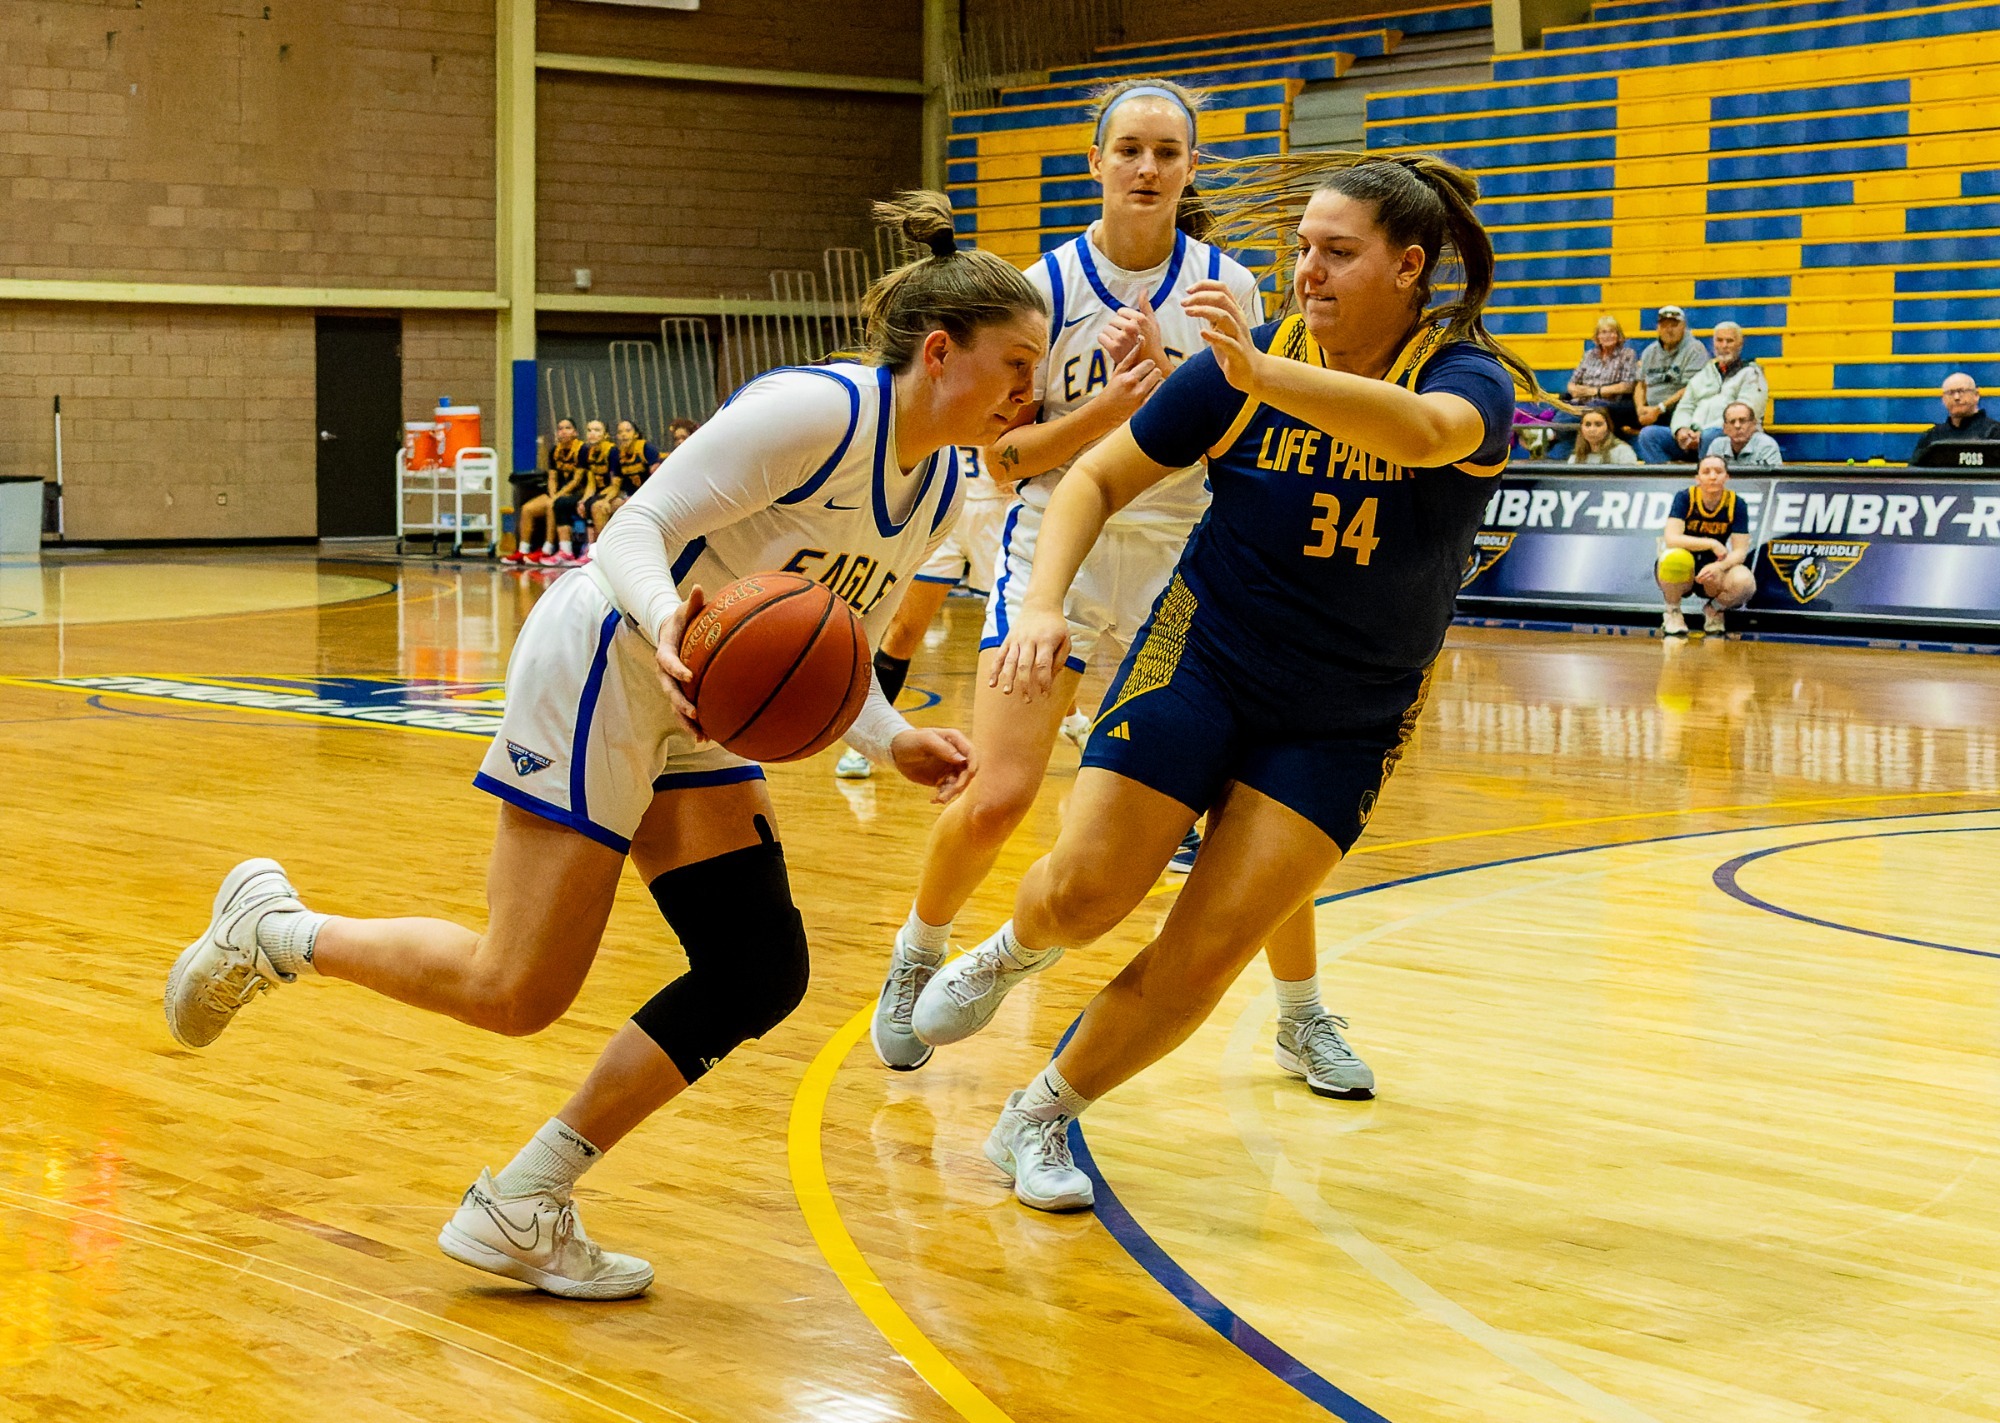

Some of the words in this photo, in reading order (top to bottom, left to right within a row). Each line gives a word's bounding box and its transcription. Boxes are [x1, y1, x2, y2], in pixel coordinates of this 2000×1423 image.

[1256, 427, 1322, 475] LIFE
[1958, 451, 1984, 467] POSS
[1303, 492, 1380, 566] 34
[1773, 492, 2000, 538] EMBRY-R
[1772, 543, 1860, 557] EMBRY-RIDDLE
